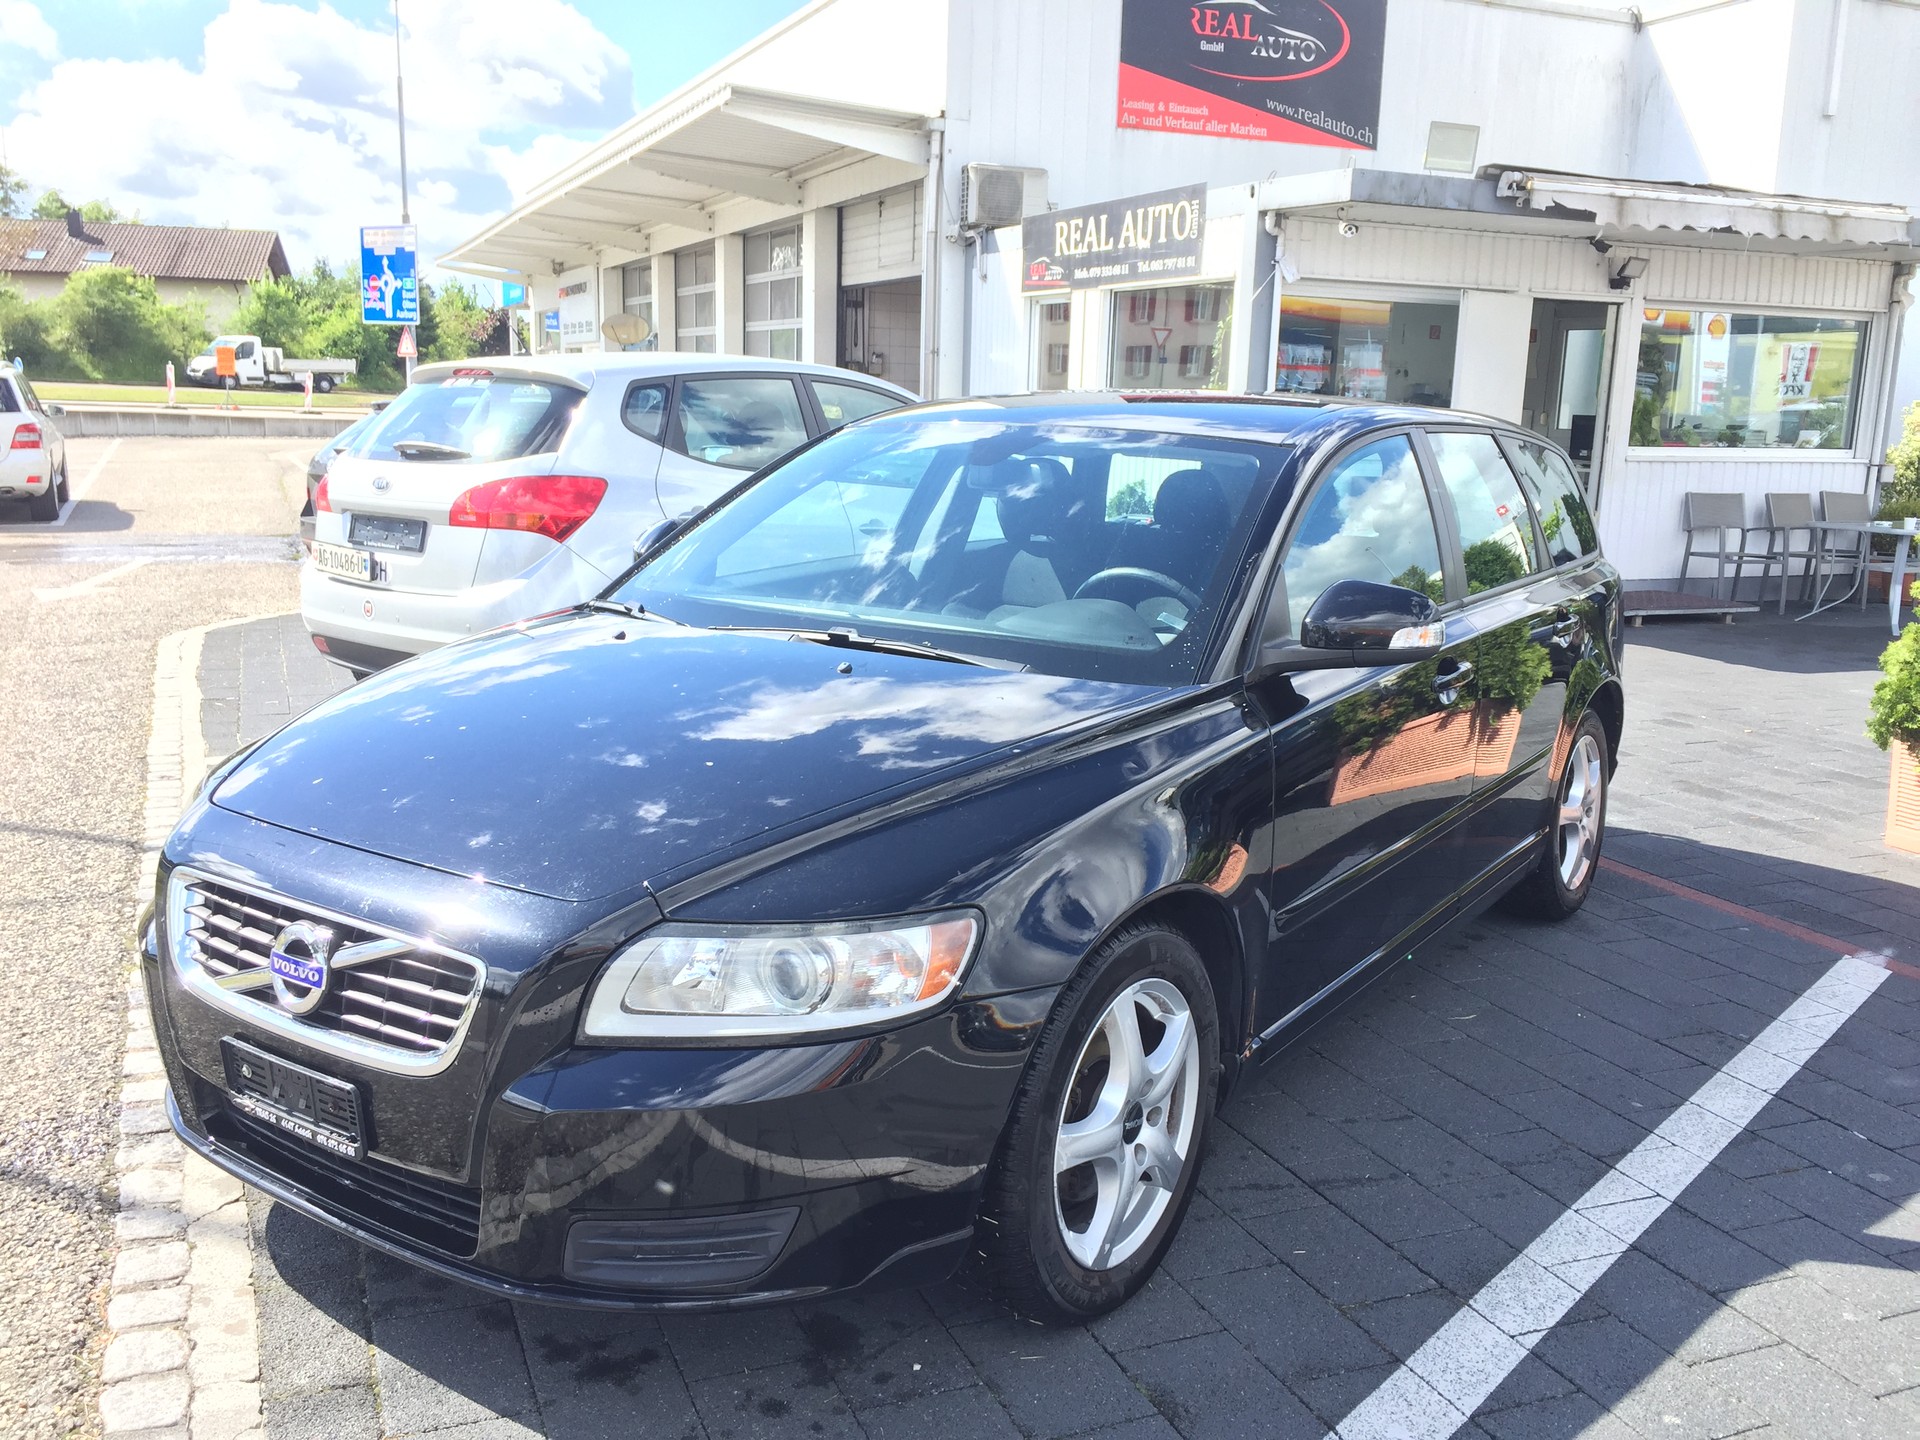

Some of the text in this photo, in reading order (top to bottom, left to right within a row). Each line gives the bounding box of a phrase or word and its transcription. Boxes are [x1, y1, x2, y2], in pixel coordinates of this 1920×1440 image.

[1190, 7, 1259, 41] REAL
[1200, 40, 1224, 52] GmbH
[1251, 35, 1317, 62] AUTO
[1122, 98, 1209, 116] Leasing & Eintausch
[1121, 112, 1267, 137] An- und Verkauf aller Marken
[1266, 98, 1374, 145] www.realauto.ch
[1054, 200, 1191, 257] REAL AUTO
[1189, 199, 1200, 239] GmbH
[1137, 260, 1151, 273] Tel.
[272, 956, 320, 983] VOLVO
